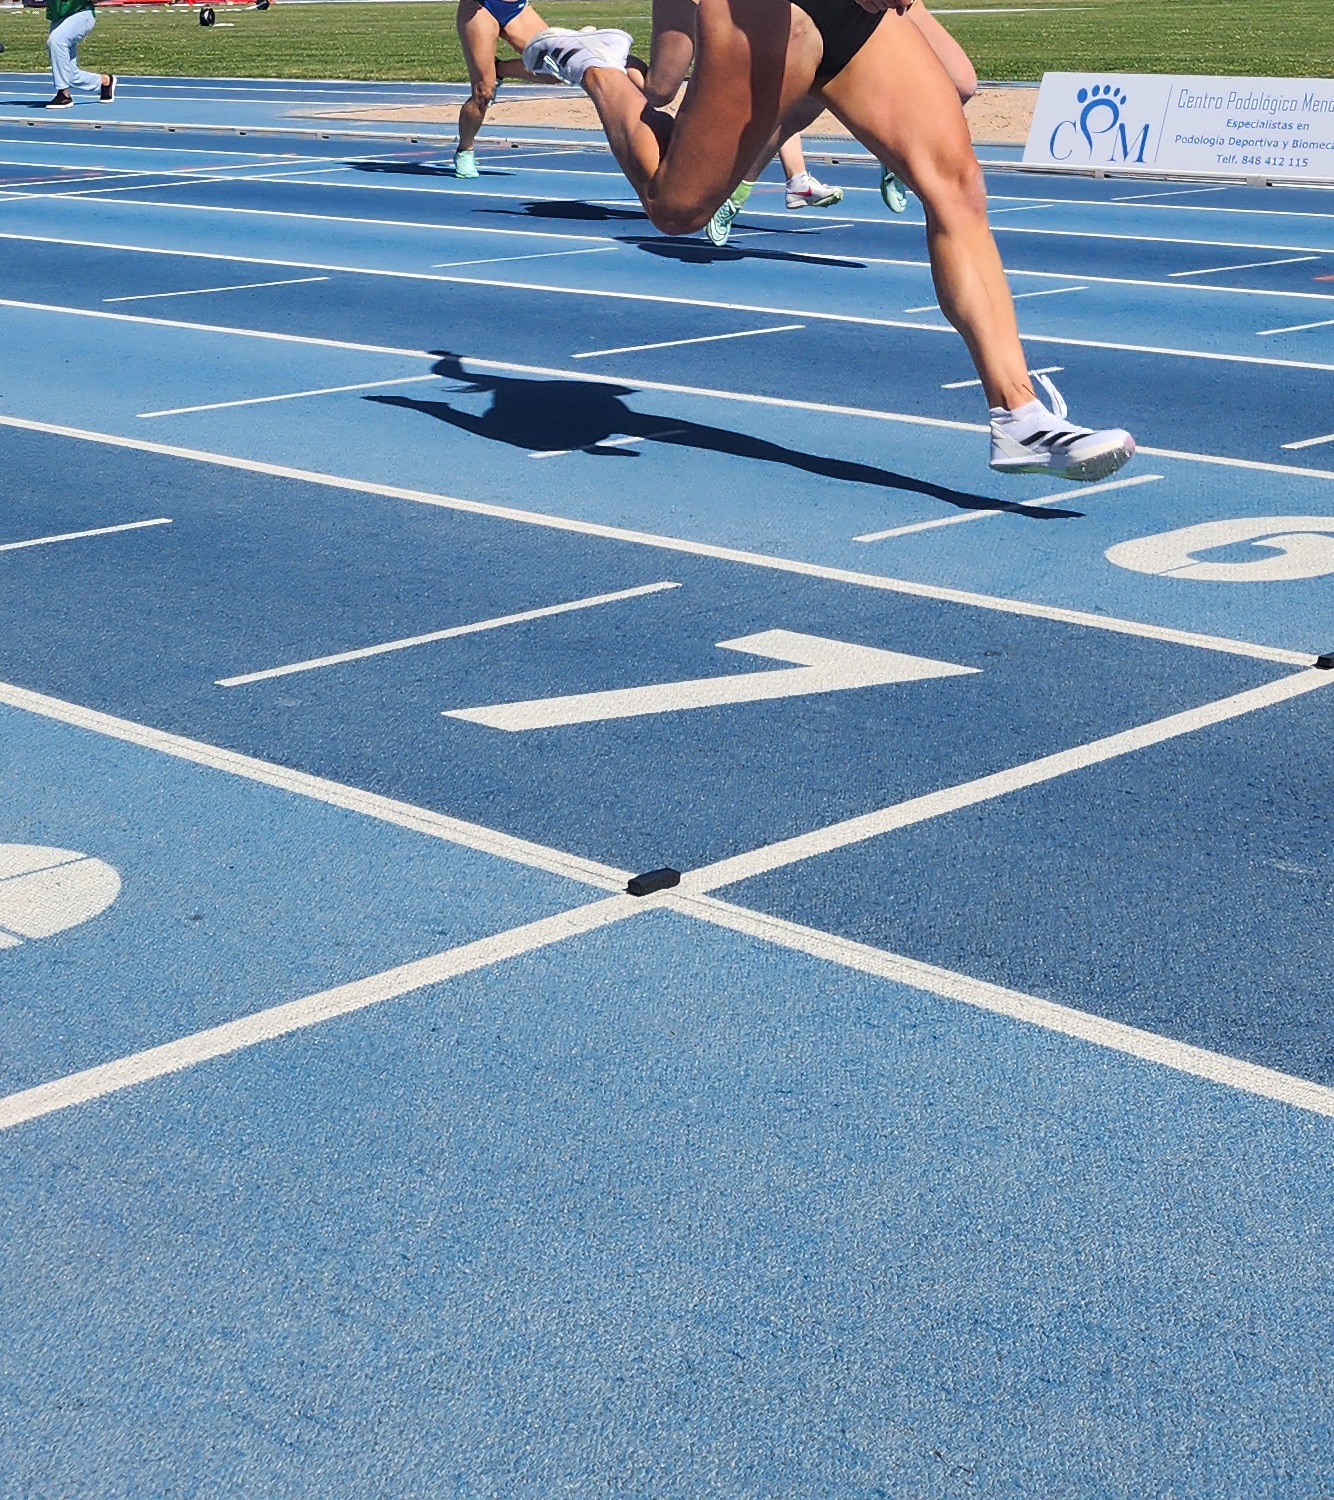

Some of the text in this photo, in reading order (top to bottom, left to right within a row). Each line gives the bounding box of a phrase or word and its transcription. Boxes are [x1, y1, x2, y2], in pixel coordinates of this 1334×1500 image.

[1177, 88, 1222, 109] Centro
[1226, 91, 1297, 114] Podológico
[1226, 119, 1310, 132] Especialistas en
[1174, 134, 1225, 147] Podología
[1228, 136, 1279, 149] Deportiva
[1282, 140, 1289, 150] y
[1216, 154, 1238, 165] Telf.
[1264, 156, 1285, 167] 412
[1288, 157, 1308, 168] 115
[441, 628, 983, 732] 7
